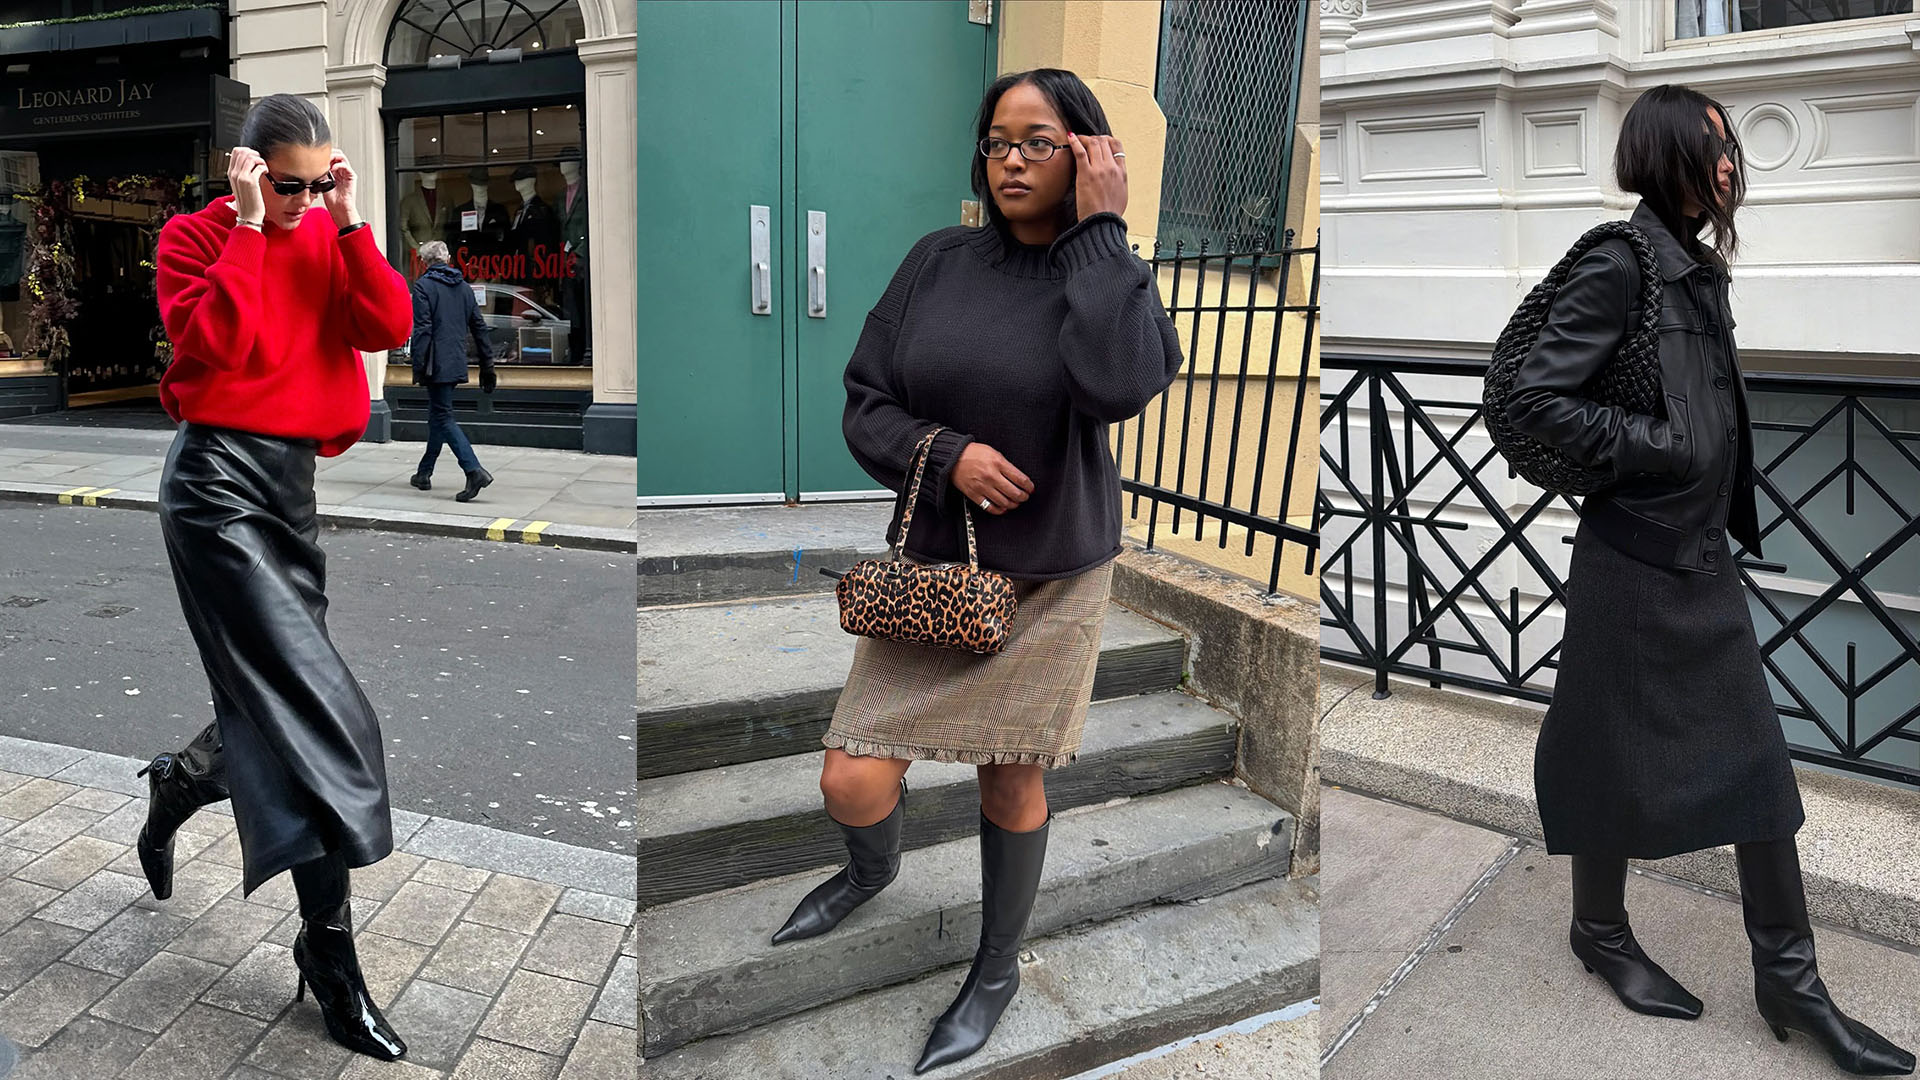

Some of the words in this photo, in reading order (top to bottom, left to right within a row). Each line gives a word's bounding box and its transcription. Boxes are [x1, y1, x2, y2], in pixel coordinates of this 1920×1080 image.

[17, 87, 112, 109] LEONARD
[117, 79, 155, 108] JAY
[33, 112, 89, 125] GENTLEMEN'S
[91, 109, 141, 121] OUTFITTERS
[532, 242, 577, 279] Sale
